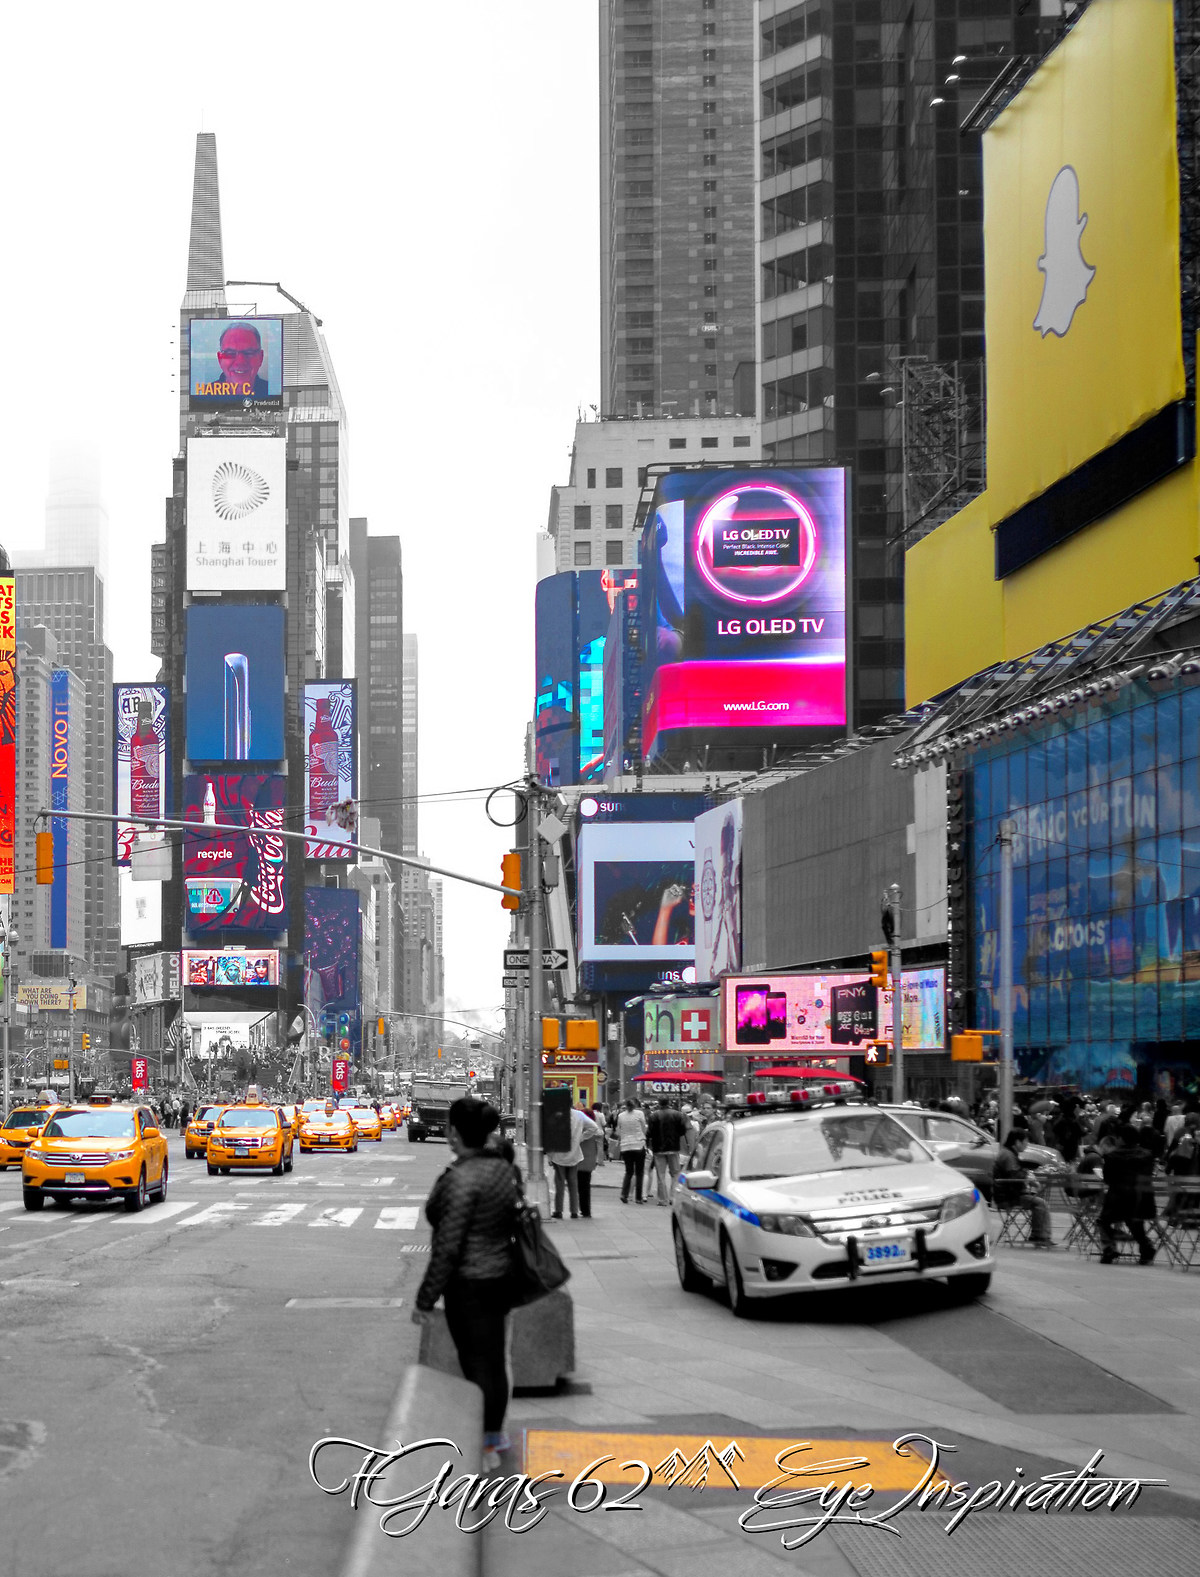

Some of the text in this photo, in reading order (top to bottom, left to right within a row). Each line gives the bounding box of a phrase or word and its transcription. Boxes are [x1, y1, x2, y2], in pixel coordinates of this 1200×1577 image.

[196, 383, 255, 396] HARRY C.
[723, 530, 738, 541] LG
[773, 529, 790, 540] TV
[195, 540, 277, 554] 上海中心
[196, 557, 278, 568] Shanghai Tower
[718, 618, 825, 635] LG OLED TV
[724, 701, 789, 711] www.LG.com
[197, 849, 233, 861] recycle
[837, 986, 863, 999] PNY
[135, 1060, 146, 1079] tkts
[335, 1062, 345, 1080] tkts
[838, 1192, 903, 1205] POLICE
[867, 1244, 900, 1260] 3892
